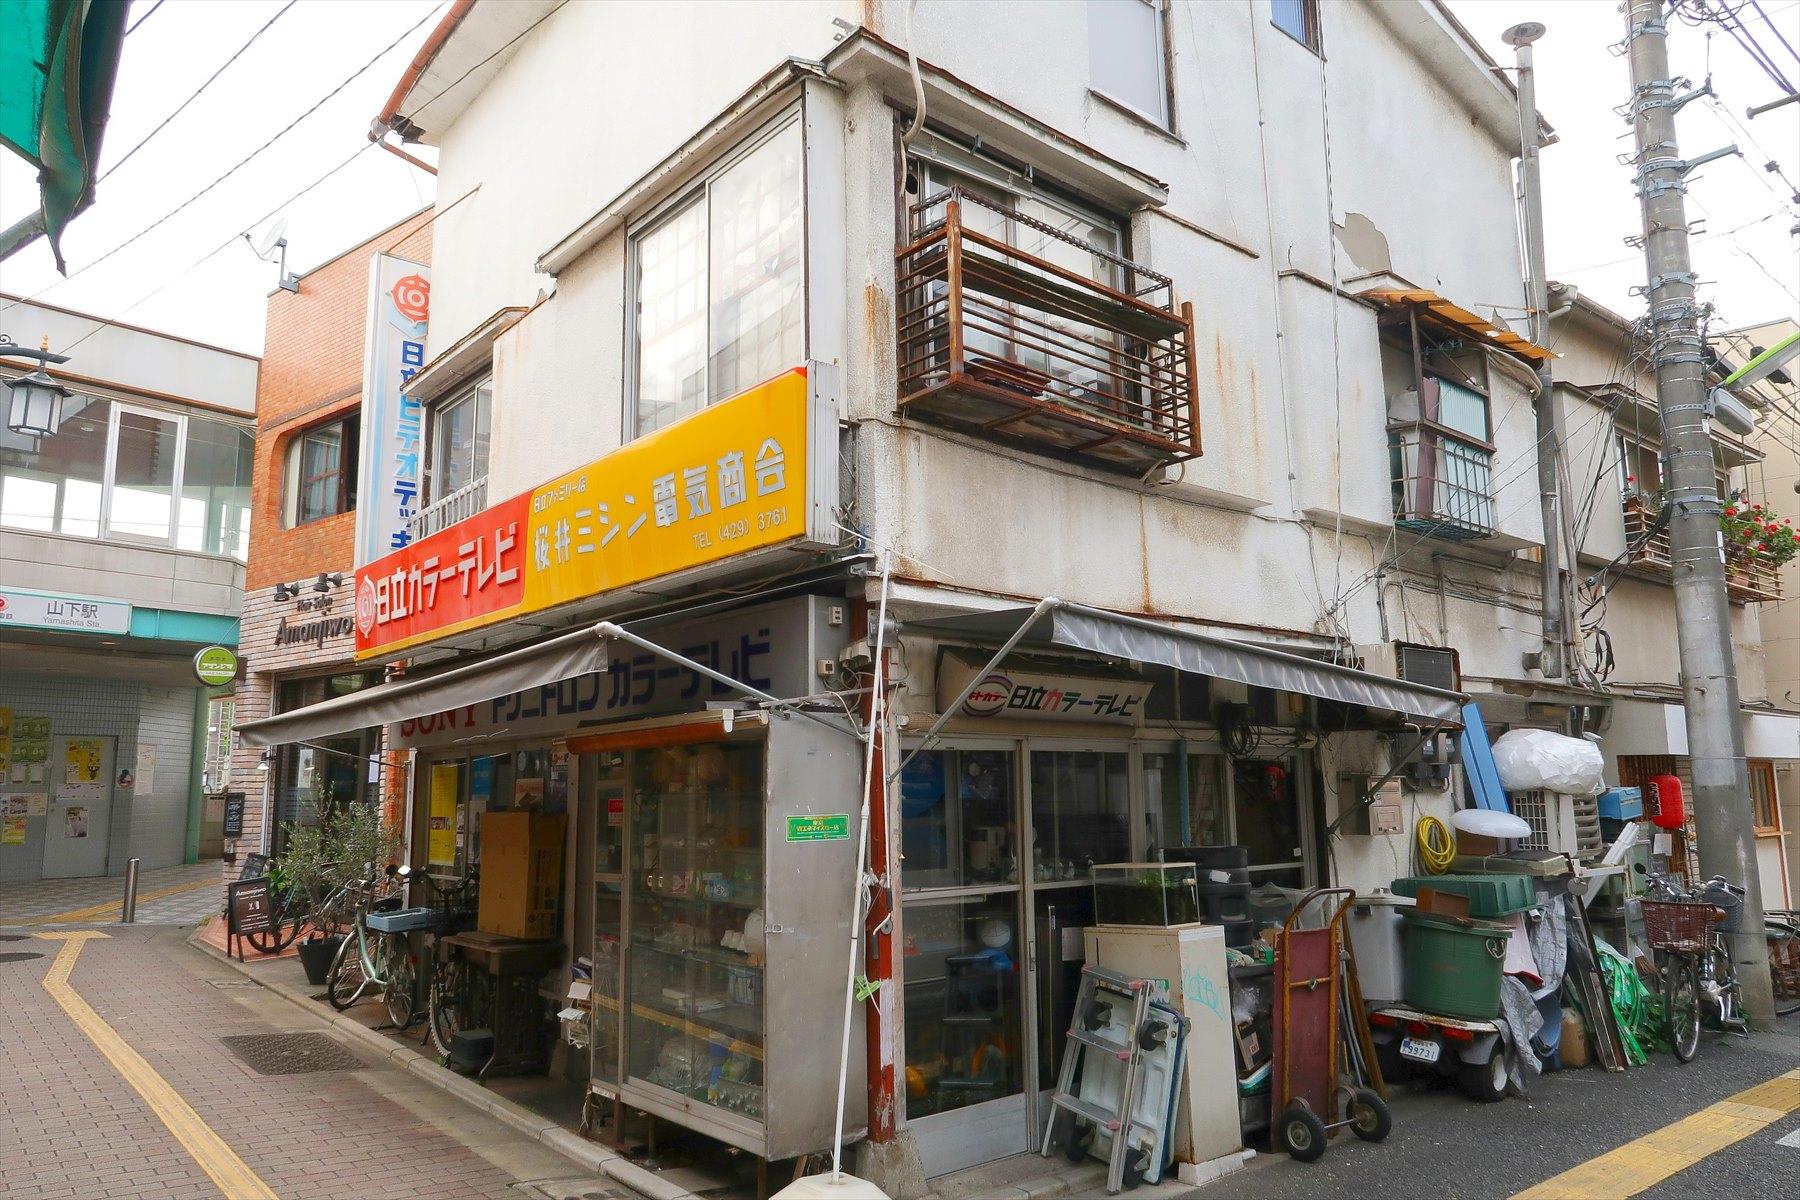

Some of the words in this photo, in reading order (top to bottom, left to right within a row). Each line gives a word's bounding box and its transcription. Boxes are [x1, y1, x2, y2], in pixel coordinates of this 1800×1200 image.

[534, 437, 786, 572] 桜井ミシン電気商会
[692, 531, 713, 550] TEL
[718, 518, 750, 541] (429)
[757, 505, 788, 531] 3761
[377, 521, 519, 625] 日立カラーテレビ
[43, 616, 85, 627] Yamashita
[86, 619, 102, 628] Sta.
[47, 600, 98, 619] 山下駅
[274, 608, 354, 650] Amanjiwo
[1007, 685, 1142, 716] 日立カラーテレビ
